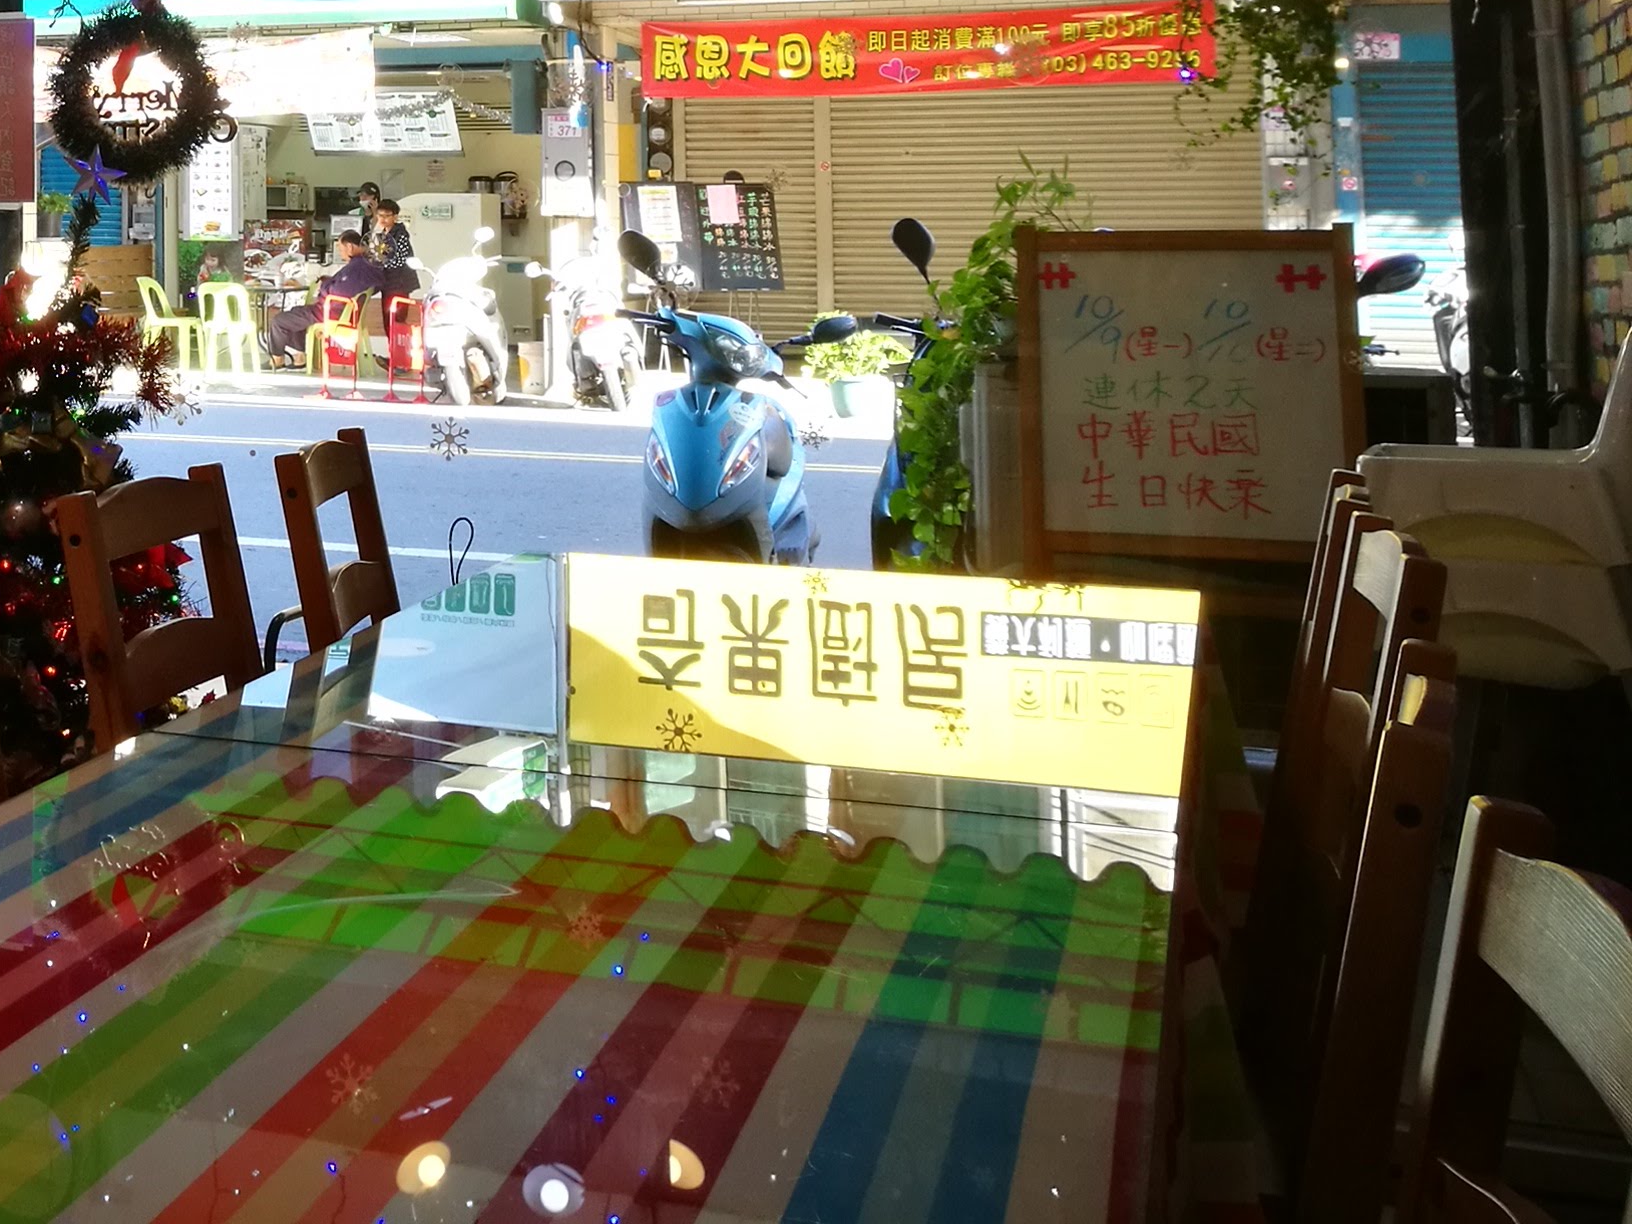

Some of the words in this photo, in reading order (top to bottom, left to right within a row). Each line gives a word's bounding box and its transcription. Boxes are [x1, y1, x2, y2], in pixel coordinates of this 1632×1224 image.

[1082, 370, 1258, 410] 連休2天
[1077, 410, 1261, 460] 中華民國
